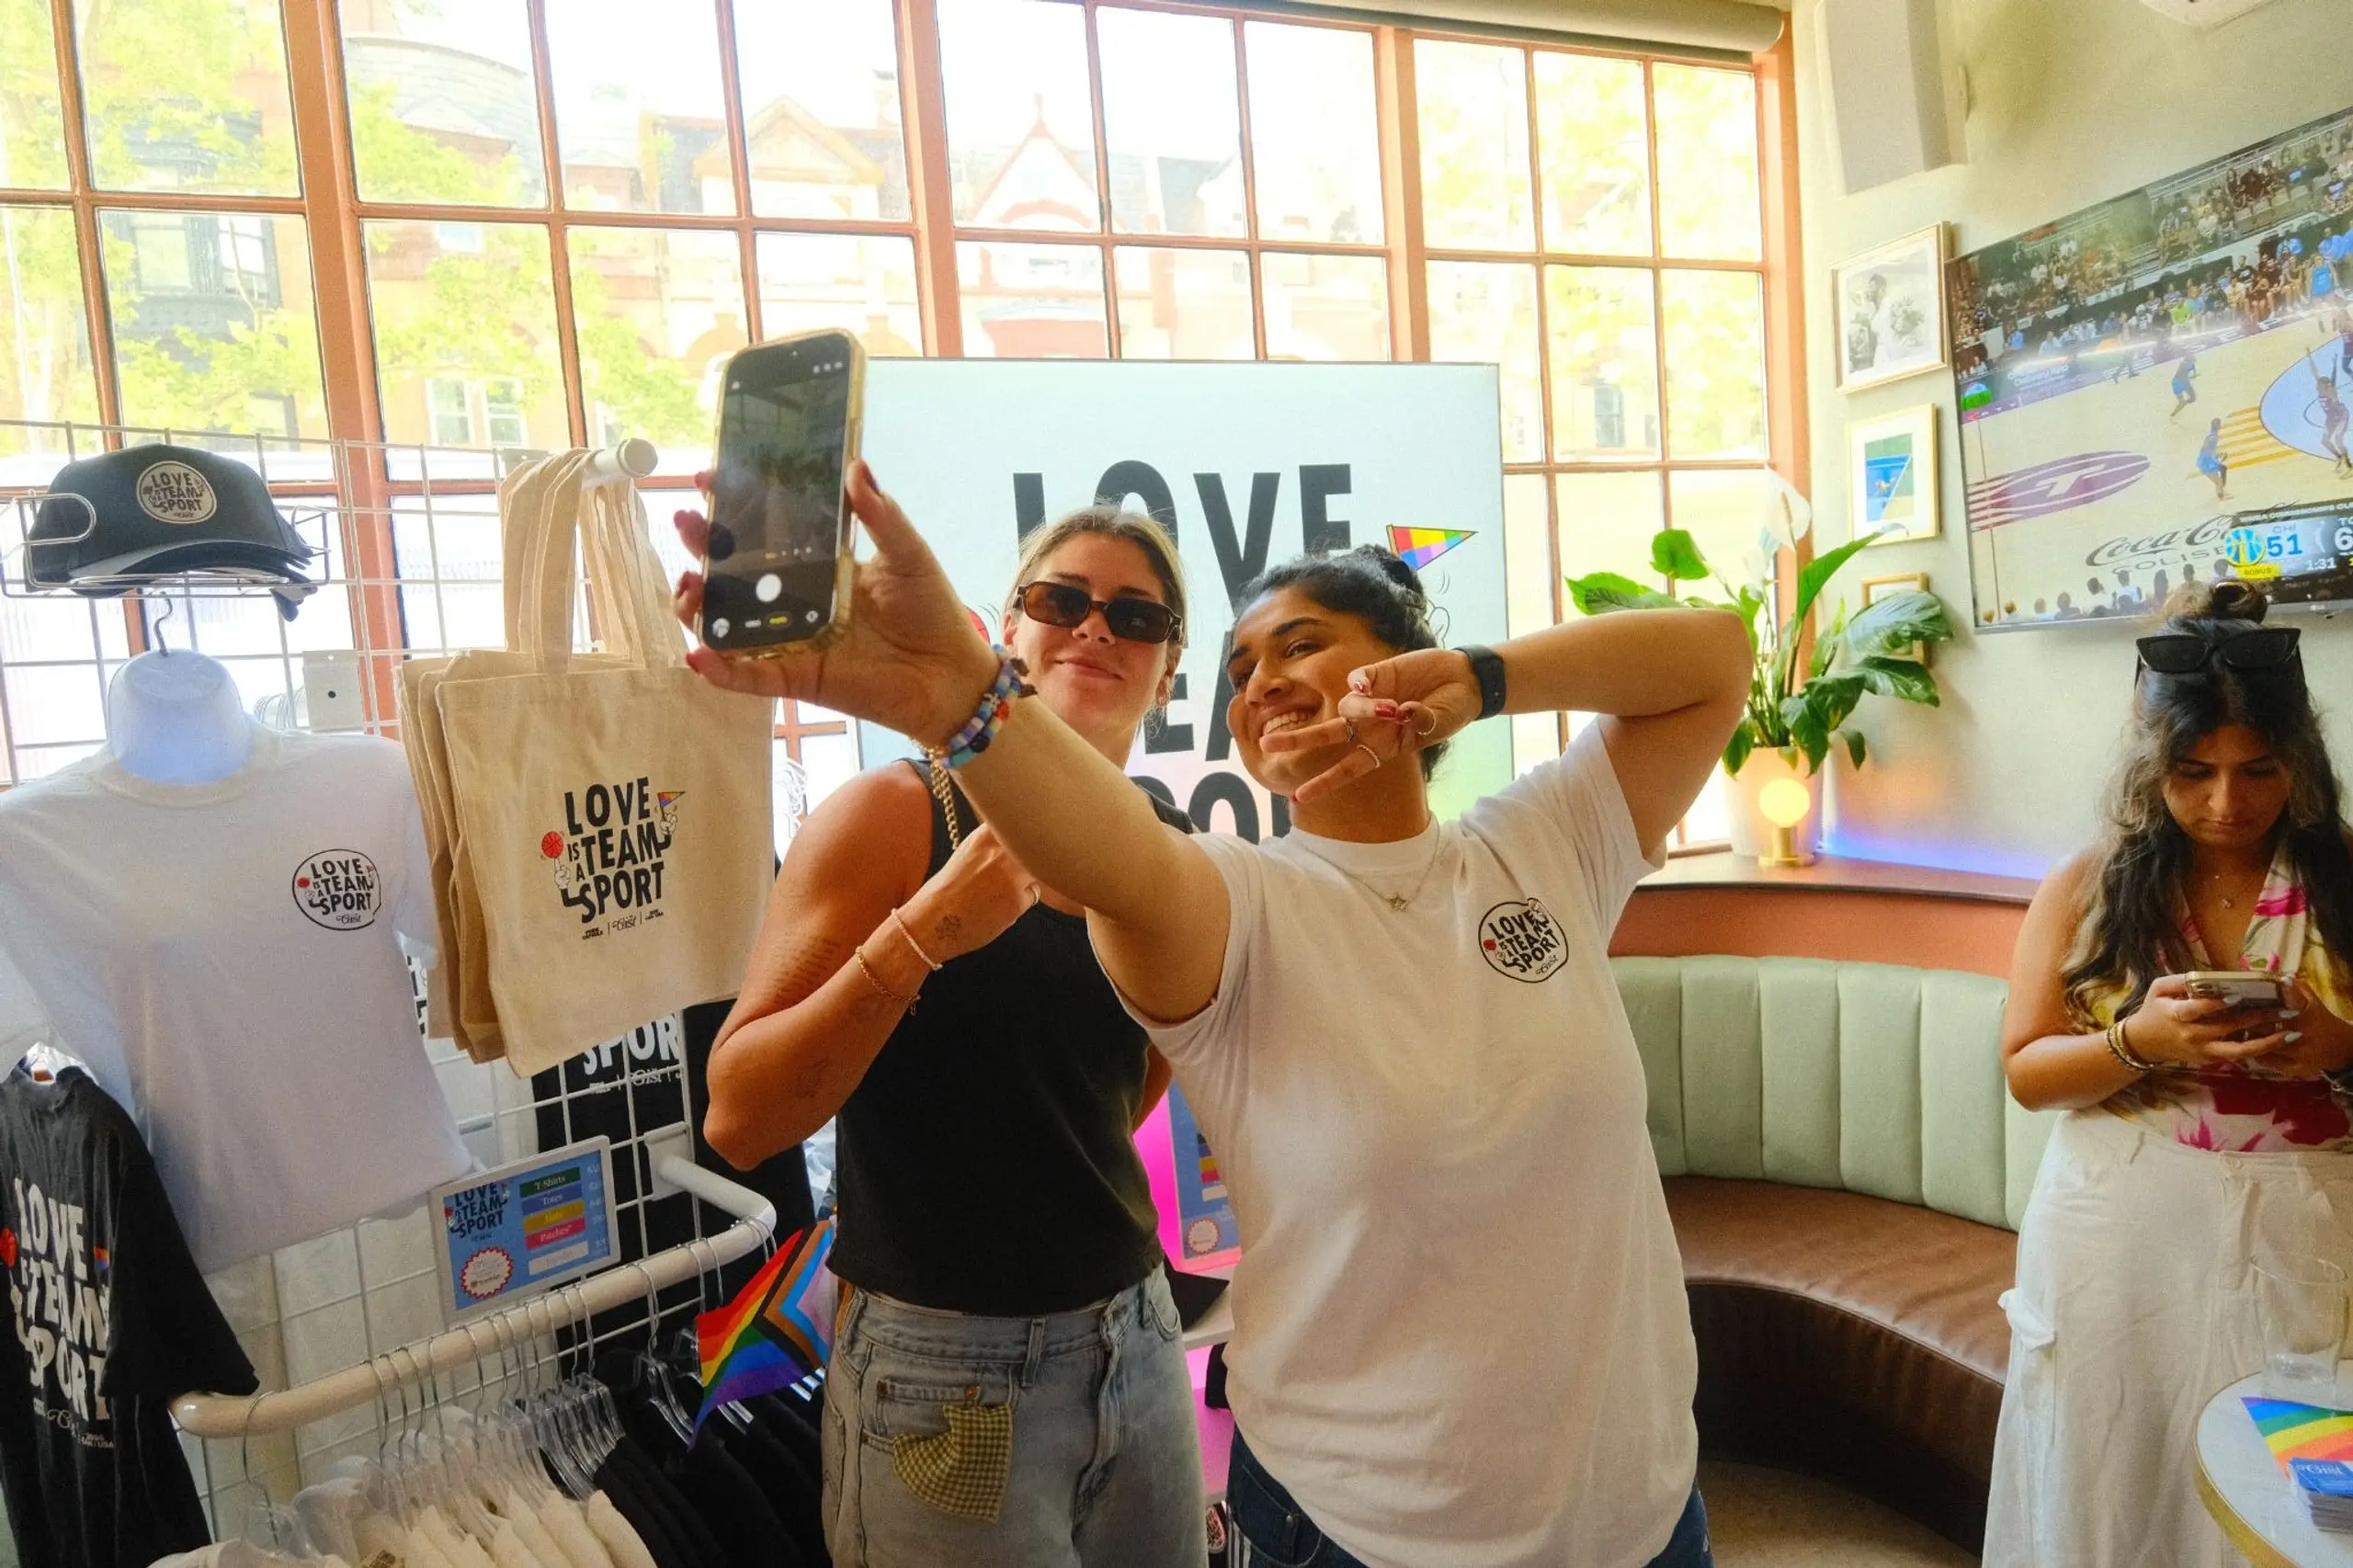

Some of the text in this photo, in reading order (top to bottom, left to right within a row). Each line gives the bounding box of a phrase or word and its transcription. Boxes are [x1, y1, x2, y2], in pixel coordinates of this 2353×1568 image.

[151, 472, 192, 488] LOVE
[160, 485, 201, 500] TEAM
[160, 499, 202, 513] SPORT
[2086, 512, 2234, 567] Coca-Co
[2267, 533, 2302, 557] 51
[2112, 545, 2227, 575] COLISE
[2307, 557, 2338, 571] 1:31
[564, 777, 651, 835] LOVE
[567, 843, 581, 862] IS
[581, 821, 662, 876] TEAM
[311, 858, 363, 879] LOVE
[576, 863, 585, 882] A
[318, 889, 324, 898] A
[321, 875, 370, 895] TEAM
[579, 861, 665, 924] SPORT
[319, 892, 371, 915] SPORT
[1488, 910, 1535, 939] LOVE
[1506, 919, 1548, 955] TEAM
[1513, 928, 1560, 973] SPORT
[455, 1182, 497, 1207] LOVE
[463, 1197, 505, 1218] TEAM
[15, 1177, 87, 1280] LOVE
[460, 1210, 504, 1239] SPORT
[27, 1256, 107, 1351] TEAM
[26, 1324, 109, 1422] SPORT
